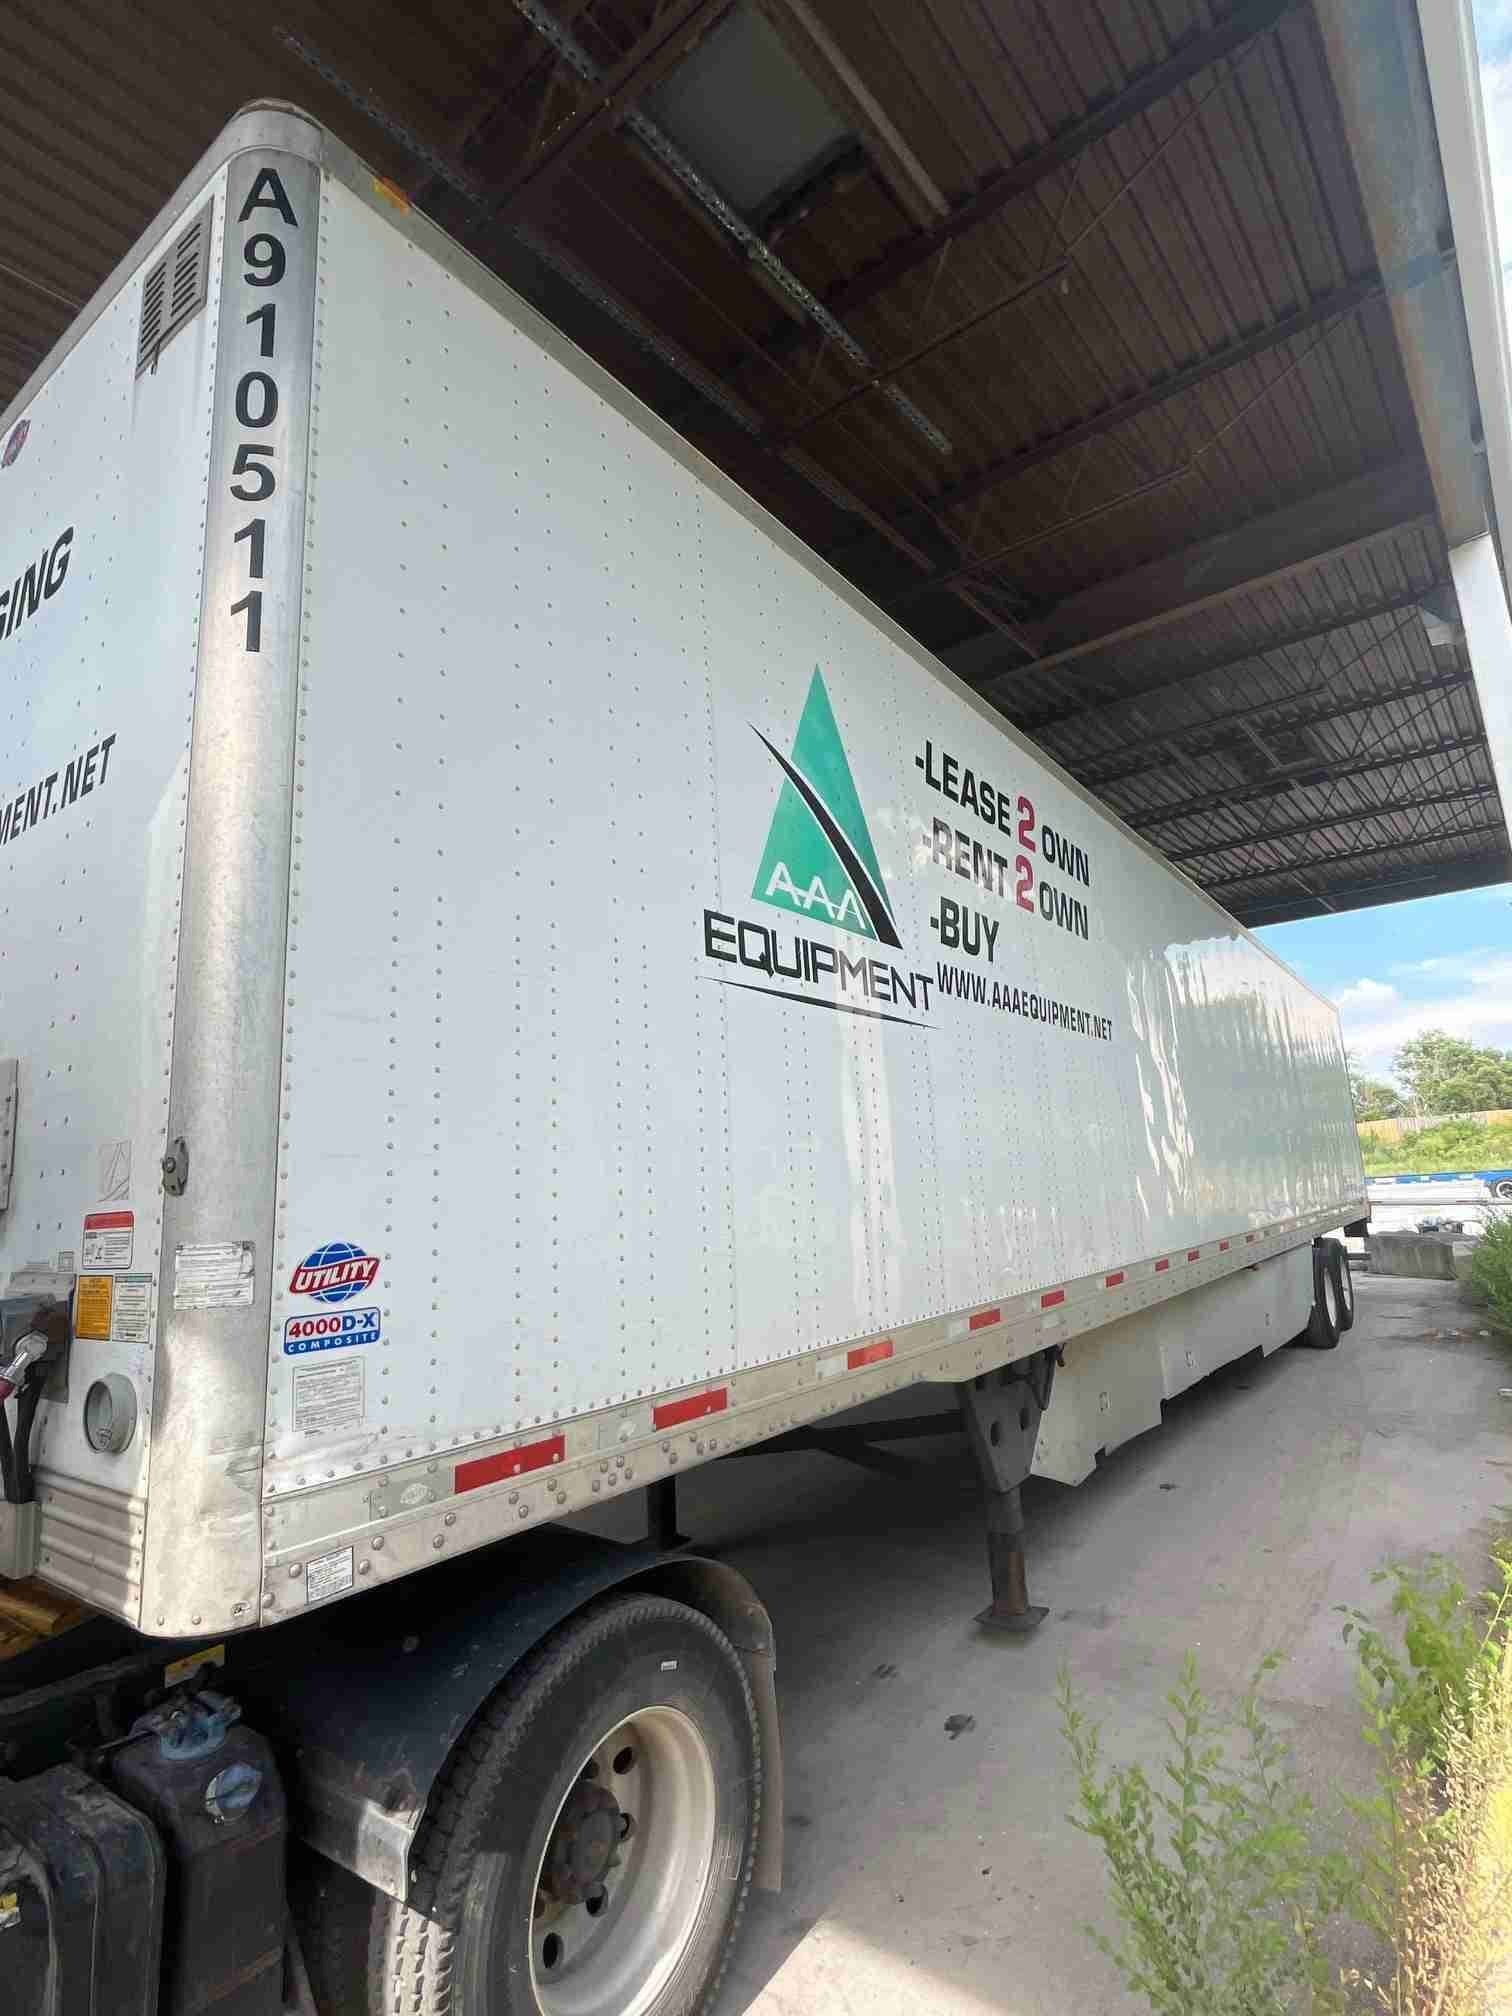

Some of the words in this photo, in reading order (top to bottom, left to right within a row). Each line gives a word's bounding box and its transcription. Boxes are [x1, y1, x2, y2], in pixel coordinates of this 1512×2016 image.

[230, 167, 299, 652] A910511
[915, 739, 1011, 837] -LEASE
[1017, 795, 1036, 853] 2
[1042, 825, 1089, 887] OWN
[765, 862, 868, 929] AAA
[922, 816, 1008, 897] -RENT
[1015, 854, 1034, 913] 2
[1039, 881, 1089, 940] OWN
[704, 909, 934, 1010] EQUIPMENT
[930, 896, 999, 962] -BUY
[937, 961, 1112, 1041] WWW.AAAEQUIPMENT.NET
[295, 1260, 377, 1290] UTILITY
[288, 1332, 377, 1353] COMPOSITE
[289, 1312, 377, 1338] 4000D-X
